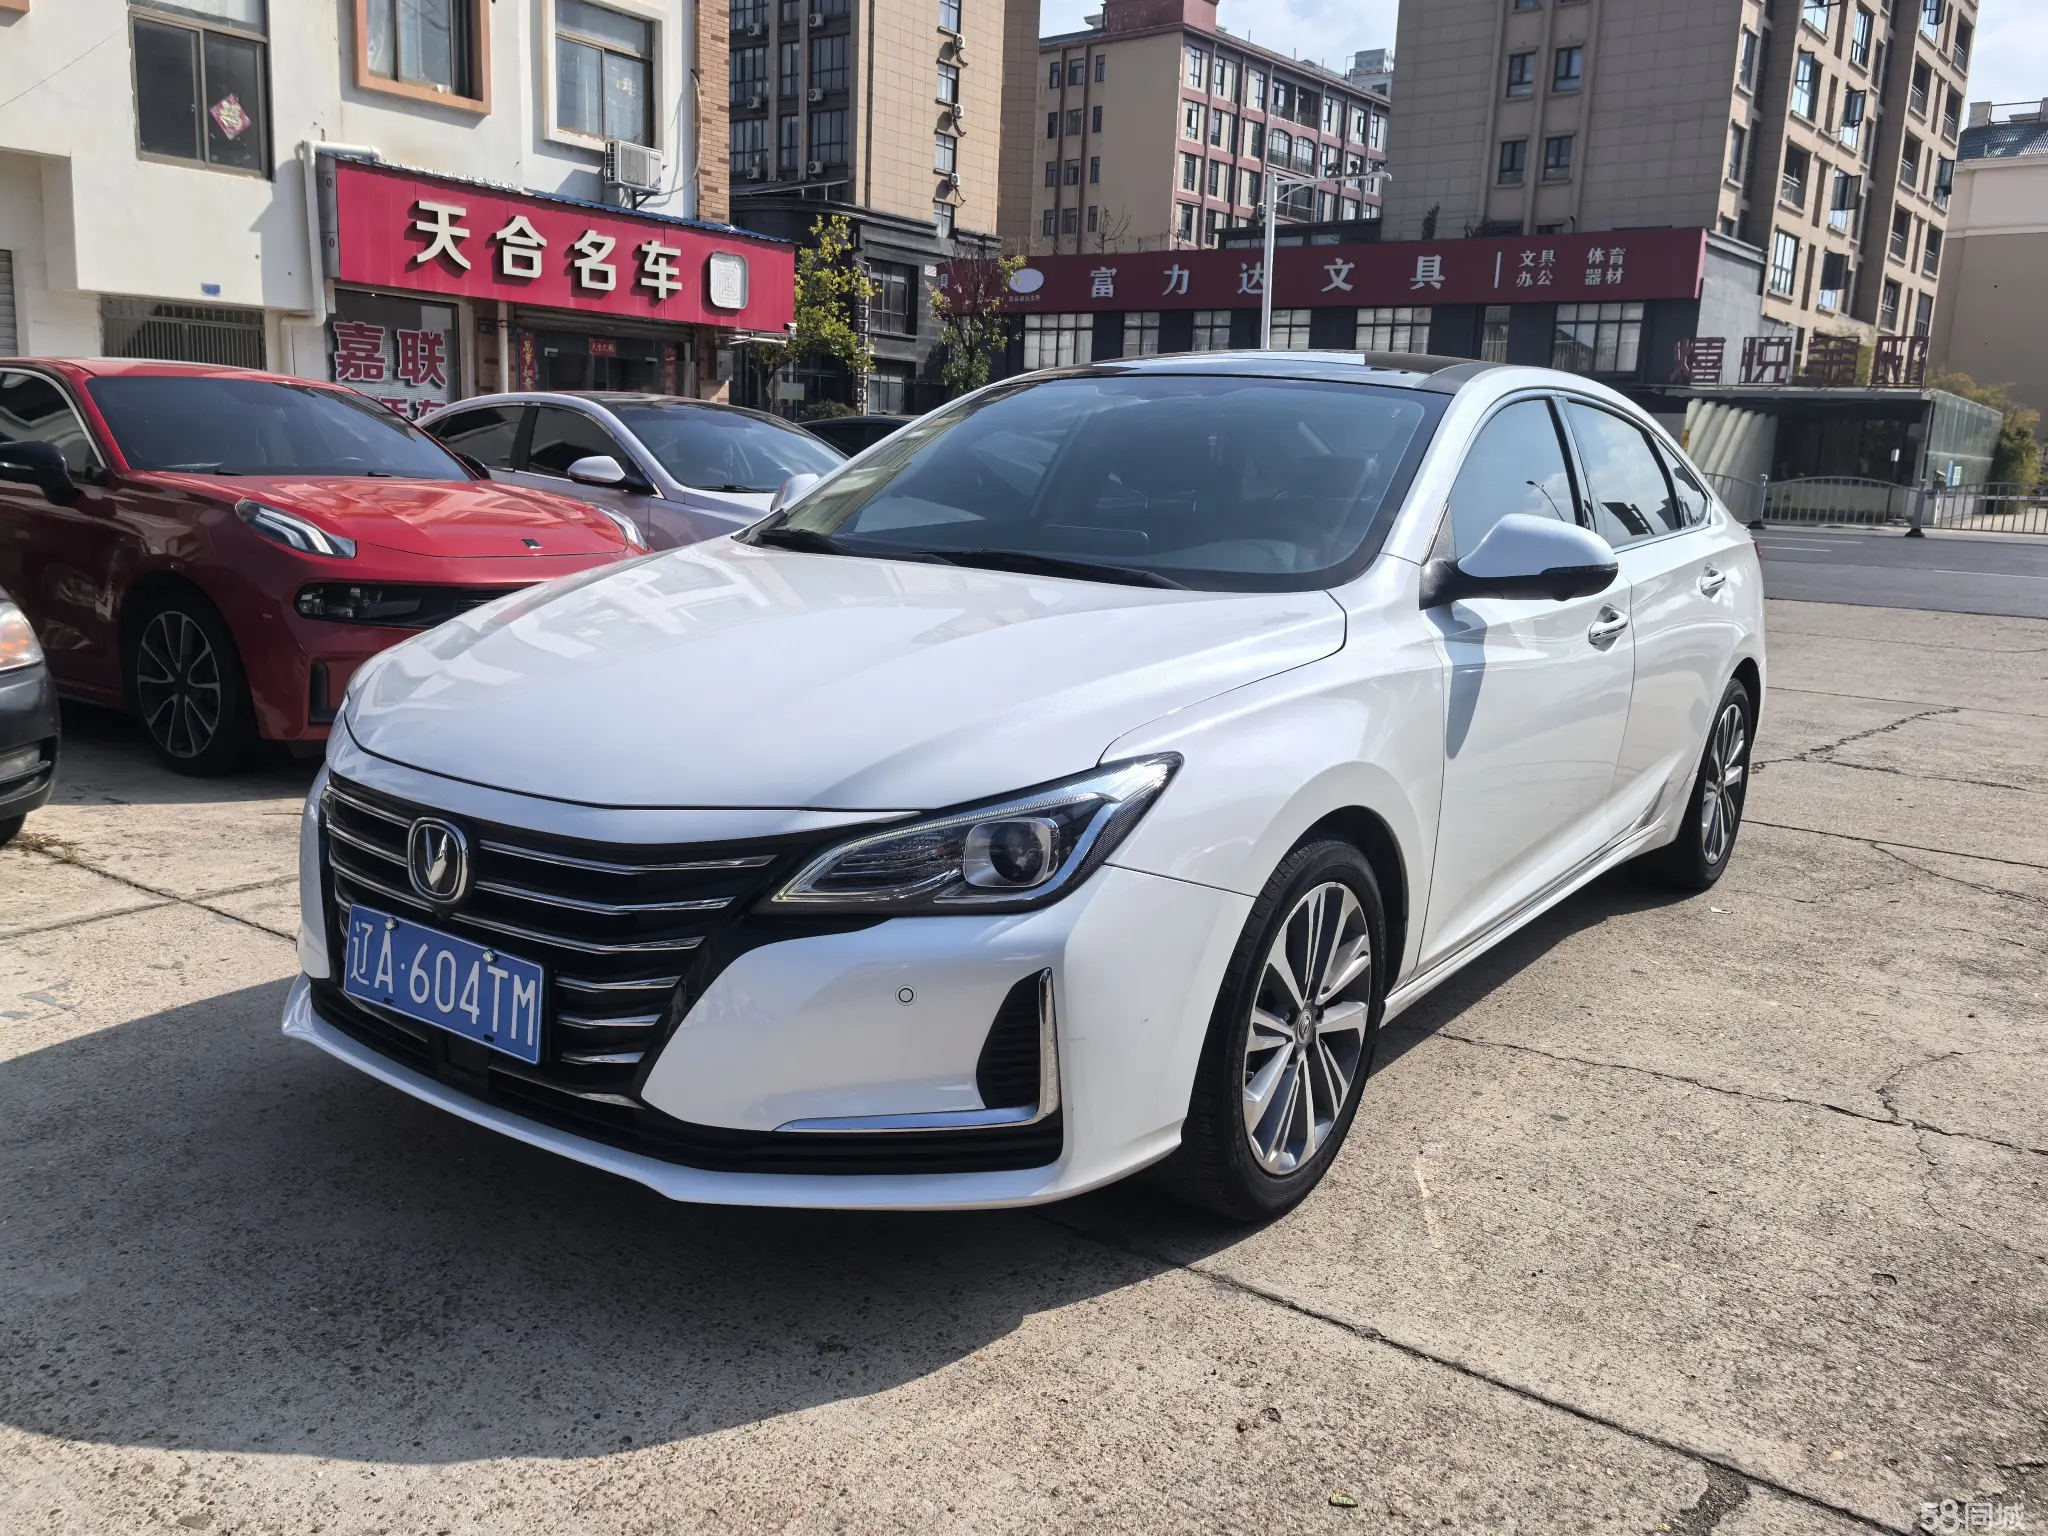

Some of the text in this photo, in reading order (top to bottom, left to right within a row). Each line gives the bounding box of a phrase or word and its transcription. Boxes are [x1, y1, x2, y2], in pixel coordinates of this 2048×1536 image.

[416, 200, 683, 299] 天合名车
[1518, 247, 1626, 267] 文具 体育
[1090, 254, 1446, 298] 富力达文具
[1516, 267, 1623, 287] 办公 器材
[333, 321, 447, 387] 嘉联
